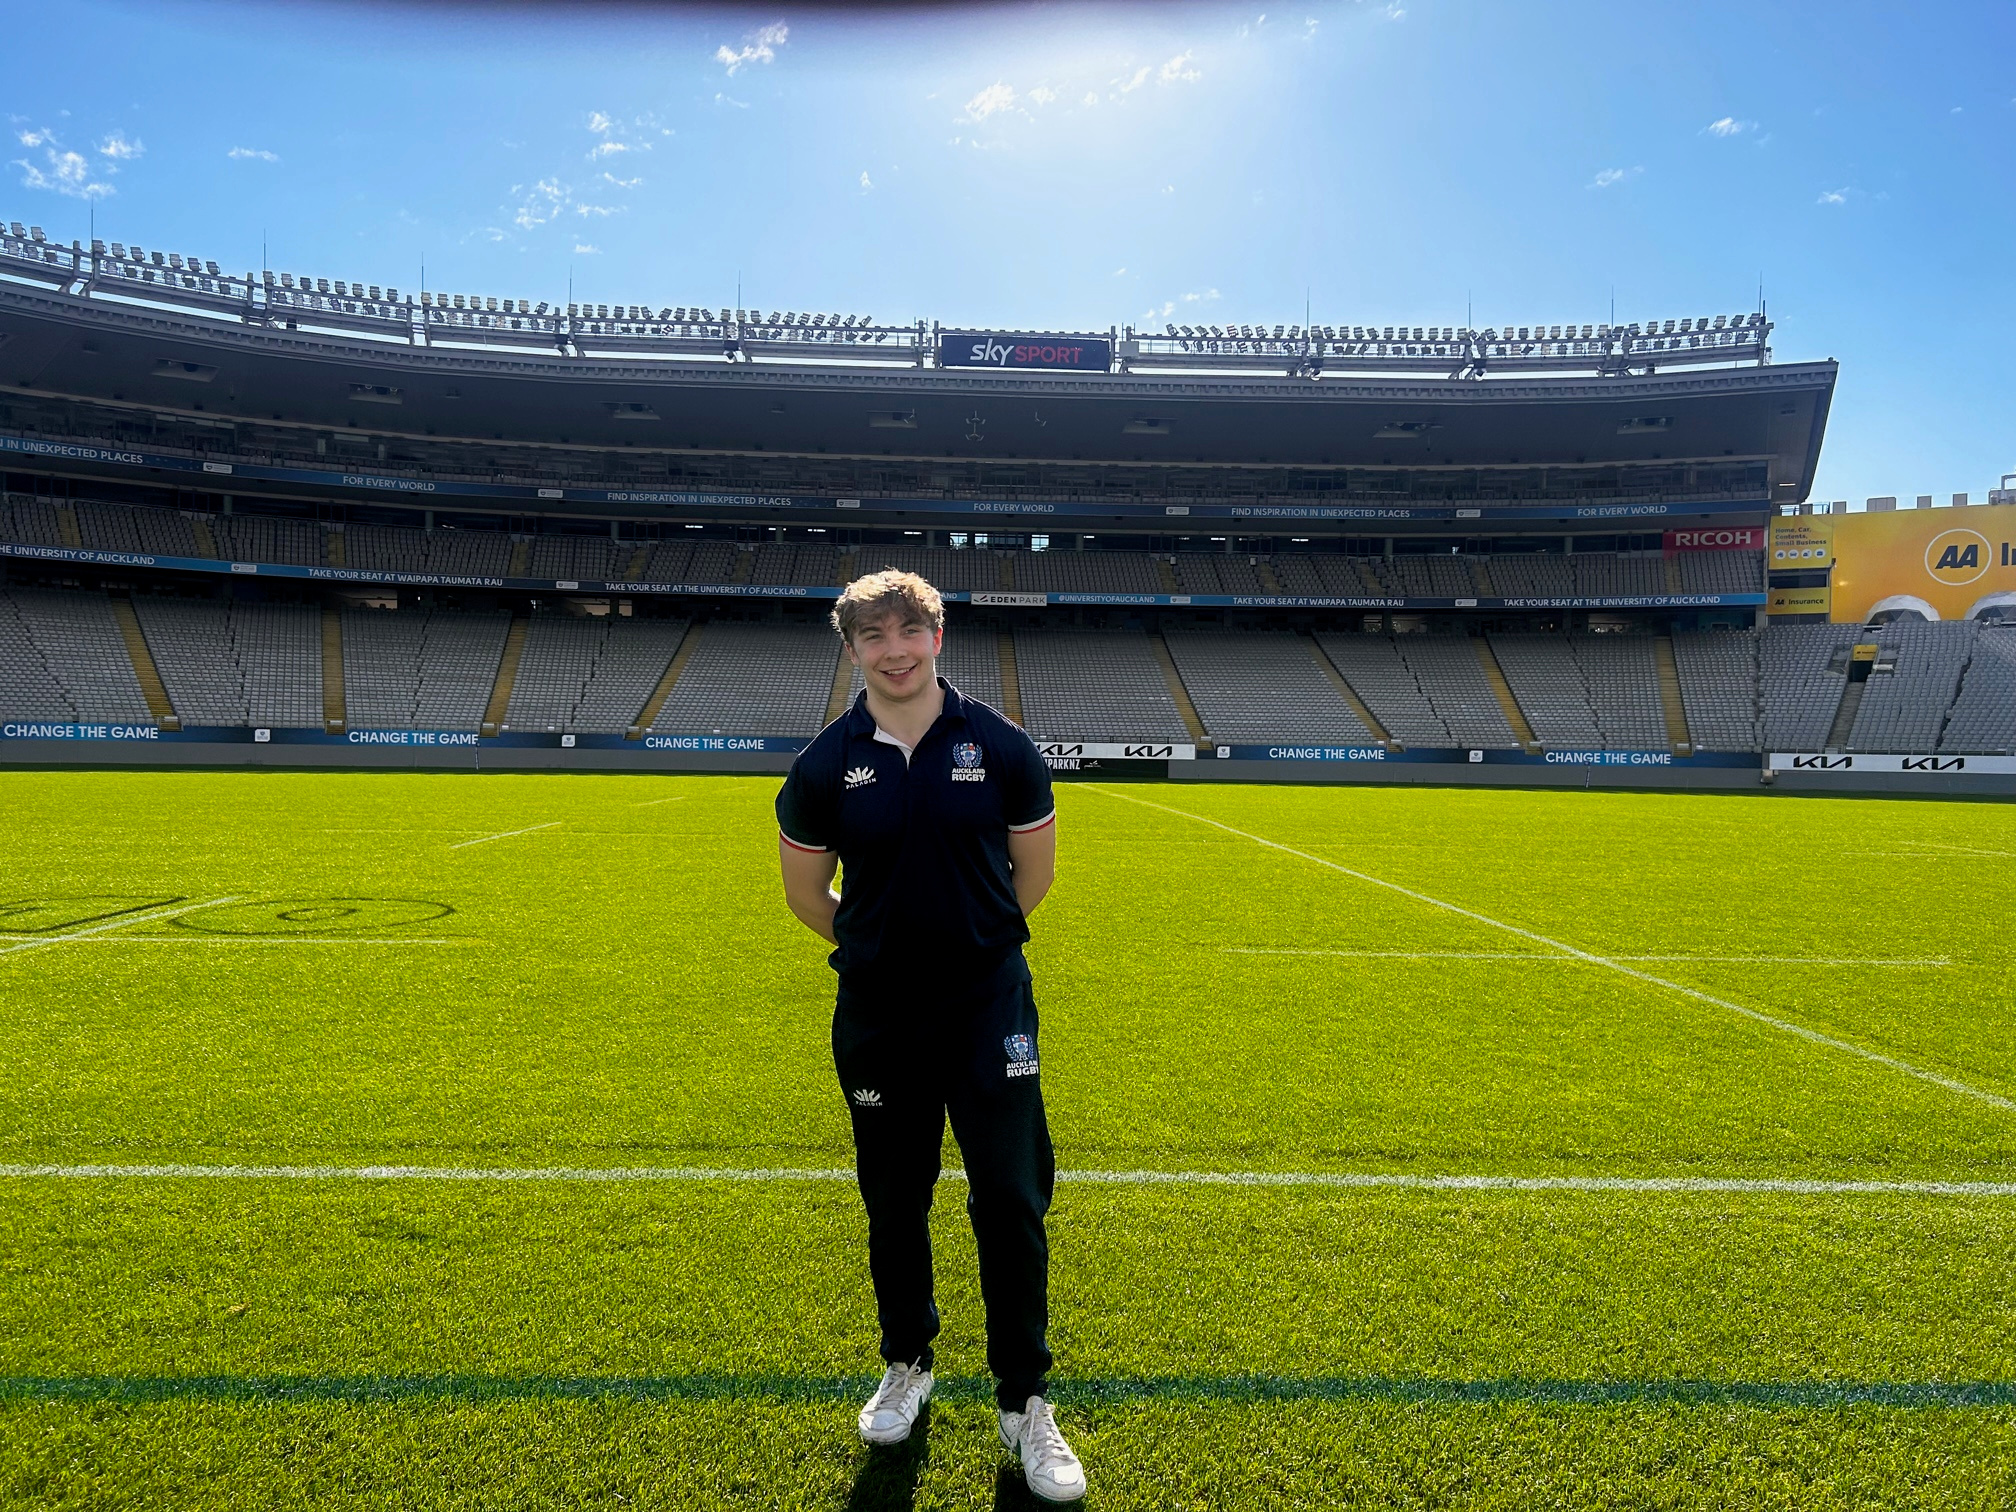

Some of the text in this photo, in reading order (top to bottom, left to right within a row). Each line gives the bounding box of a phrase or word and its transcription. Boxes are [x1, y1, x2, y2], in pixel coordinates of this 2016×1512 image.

[970, 338, 1083, 366] sky SPORT
[7, 439, 19, 449] IN
[23, 441, 98, 459] UNEXPECTED
[101, 450, 143, 464] PLACES
[343, 475, 435, 492] FOR EVERY WORLD
[607, 492, 791, 506] FIND INSPIRATION IN UNEXPECTED PLACES
[973, 503, 1054, 513] FOR EVERY WORLD
[1231, 507, 1410, 518] FIND INSPIRATION IN UNEXPECTED PLACES
[1577, 505, 1667, 516] FOR EVERY WORLD
[1675, 531, 1751, 546] RICOH
[14, 546, 77, 560] UNIVERSITY
[79, 550, 95, 561] OF
[96, 553, 155, 566] AUCKLAND
[1935, 544, 1979, 569] AA
[308, 568, 503, 587] TAKE YOUR SEAT AT WAIPAPA TAUMATA RAU
[605, 582, 807, 596] TAKE YOUR SEAT AT THE UNIVERSITY OF AUCKLAND
[990, 595, 1045, 605] EDEN PARK
[1058, 594, 1155, 604] @UNIVERSITYOFAUCKLAND
[1233, 596, 1404, 607] TAKE YOUR SEAT AT WAIPAPA TAUMATA RAU
[1503, 595, 1720, 607] TAKE YOUR SEAT AT THE UNIVERSITY OF AUCKLAND
[4, 724, 158, 739] CHANGE THE GAME
[349, 731, 479, 745] CHANGE THE GAME
[645, 737, 764, 750] CHANGE THE GAME
[1269, 748, 1385, 760] CHANGE THE GAME
[1545, 752, 1671, 764] CHANGE THE GAME
[1006, 1060, 1038, 1069] AUCKLAN
